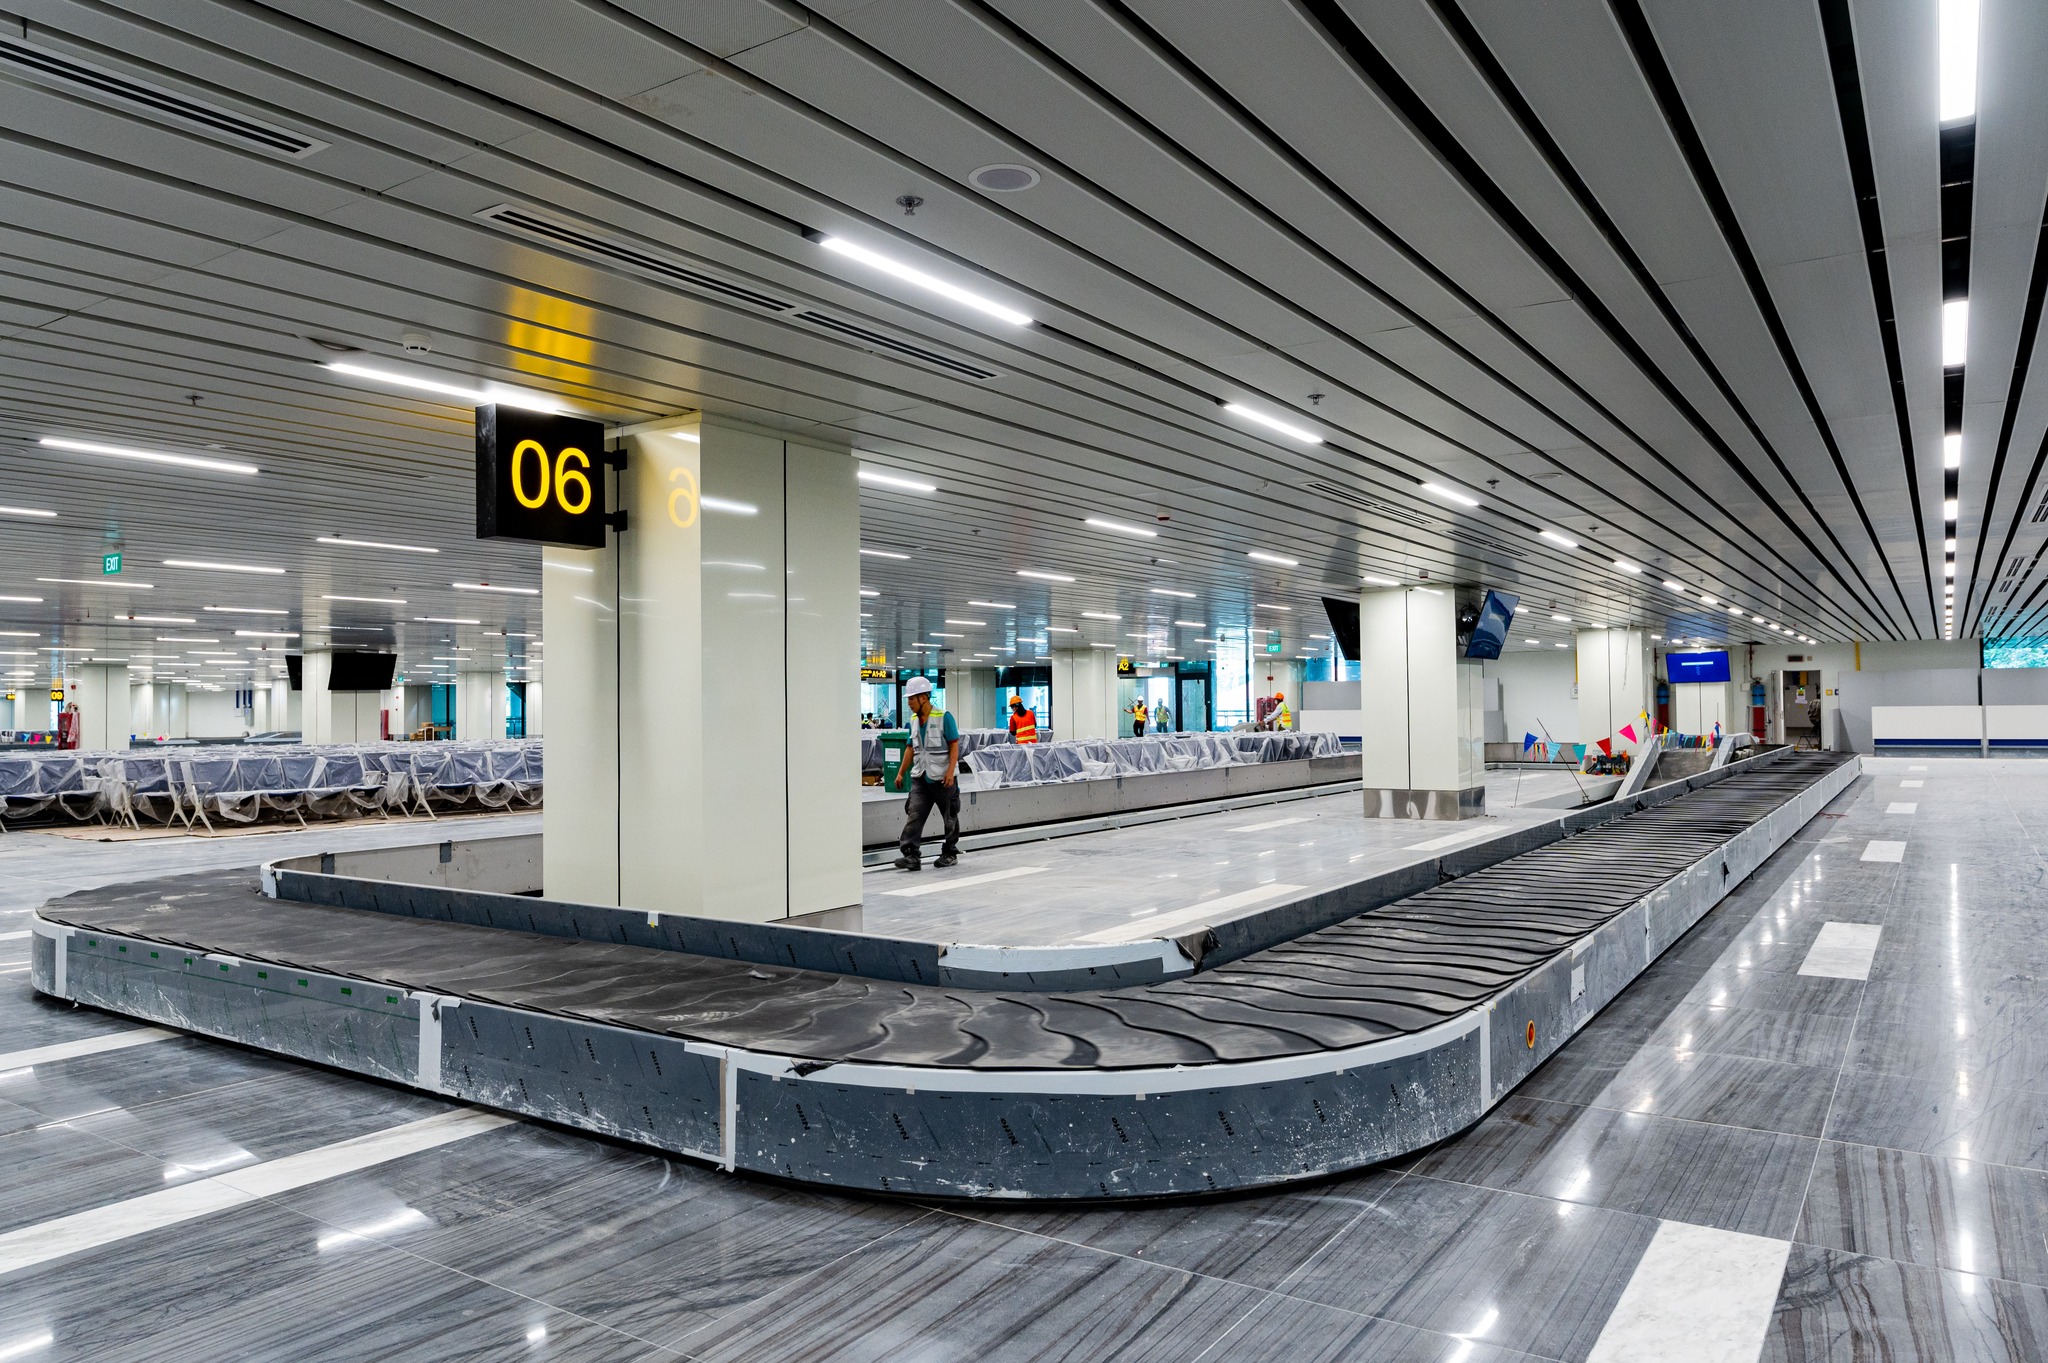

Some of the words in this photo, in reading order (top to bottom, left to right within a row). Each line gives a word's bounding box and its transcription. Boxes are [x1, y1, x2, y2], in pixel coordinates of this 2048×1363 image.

[511, 439, 592, 515] 06
[106, 556, 119, 572] EXIT
[1118, 662, 1129, 671] A2
[51, 691, 64, 700] 09
[650, 1050, 662, 1076] Nitto
[796, 1103, 811, 1131] Nitto
[892, 1112, 910, 1141] Nitto
[1218, 1110, 1235, 1137] Nitto
[1001, 1117, 1019, 1146] Nitto
